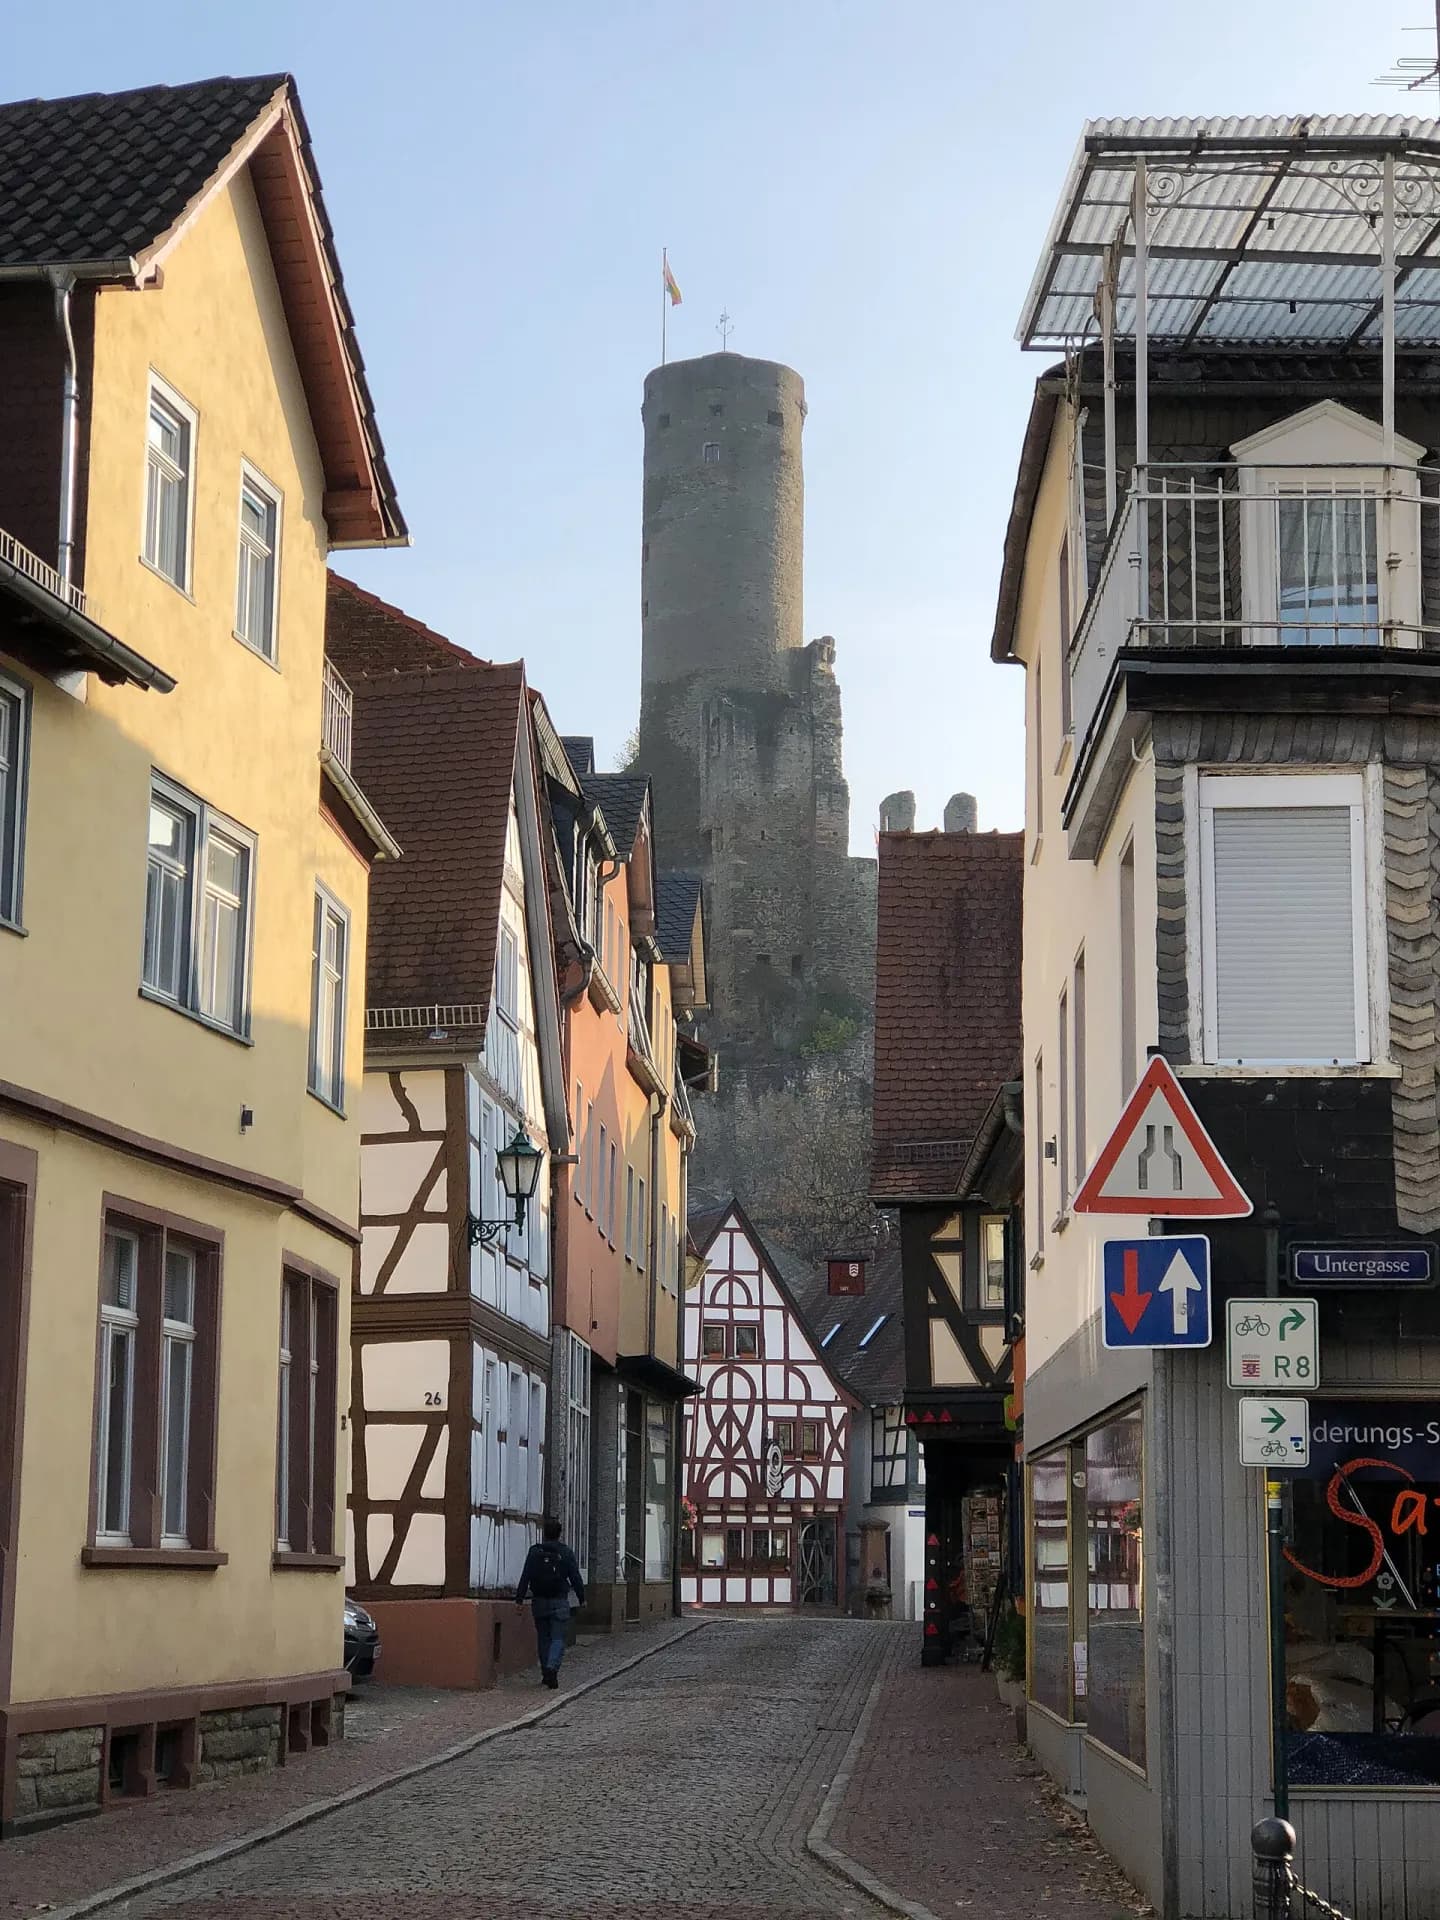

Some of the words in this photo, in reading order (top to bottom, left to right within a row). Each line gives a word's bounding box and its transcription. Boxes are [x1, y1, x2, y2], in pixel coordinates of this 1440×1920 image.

[1314, 1255, 1410, 1276] Untergasse
[424, 1391, 442, 1406] 26
[1309, 1420, 1440, 1449] derungs-S
